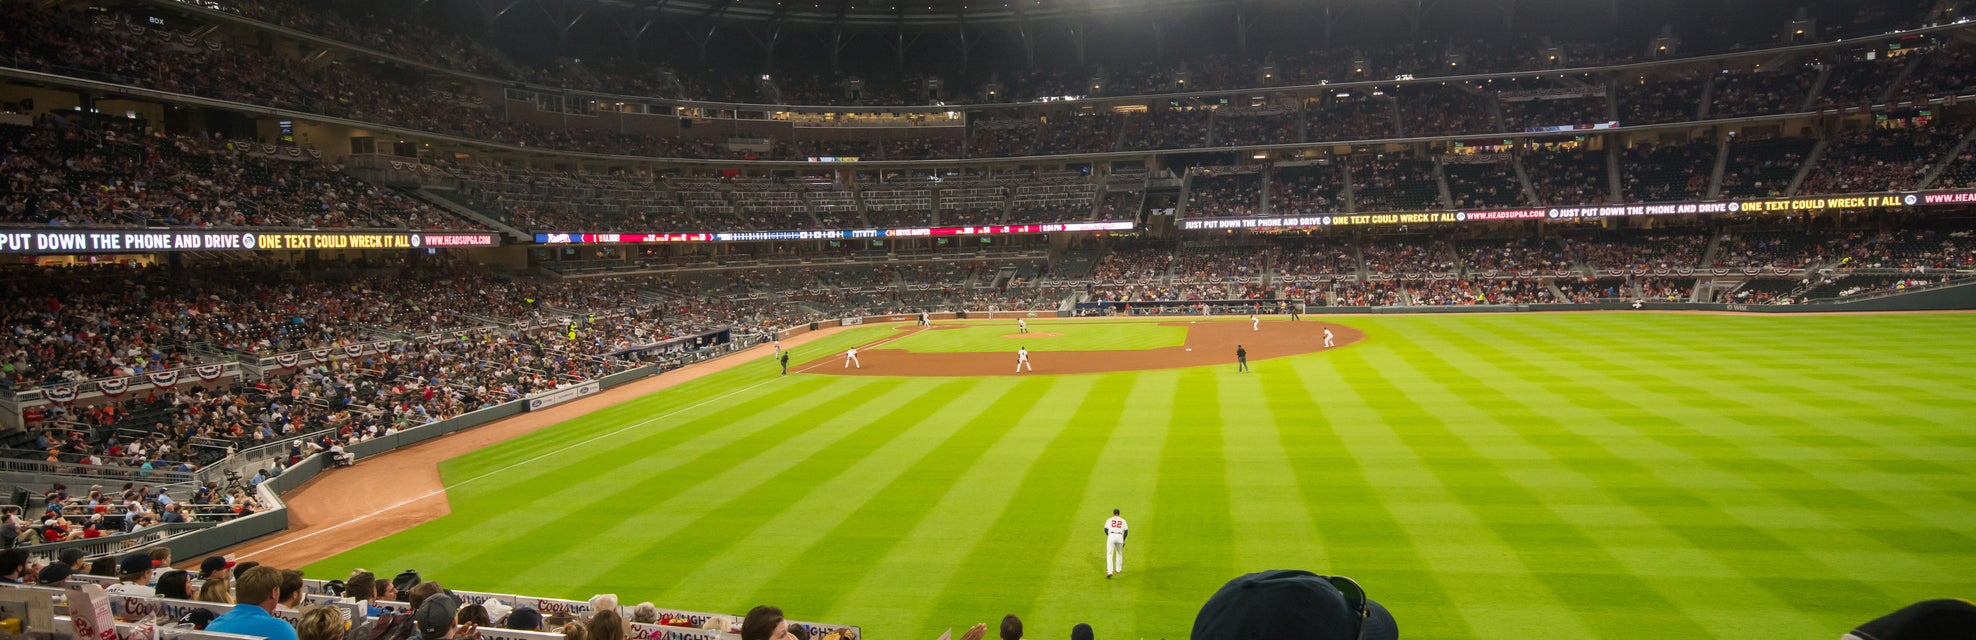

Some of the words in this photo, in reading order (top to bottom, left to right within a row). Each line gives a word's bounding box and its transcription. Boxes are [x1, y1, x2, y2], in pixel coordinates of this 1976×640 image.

[149, 16, 164, 25] BOX
[1741, 202, 1762, 211] ONE
[1765, 201, 1790, 210] TEXT
[1792, 200, 1825, 209] COULD
[1828, 198, 1865, 207] WRECK
[1868, 197, 1879, 206] IT
[1882, 196, 1901, 205] ALL
[1467, 210, 1545, 219] WWW.HEADSUPGA.COM
[1560, 209, 1579, 217] JUST
[1581, 208, 1598, 216] PUT
[1600, 207, 1625, 215] DOWN
[1627, 207, 1643, 215] THE
[1646, 205, 1675, 213] PHONE
[1678, 205, 1696, 213] AND
[1699, 204, 1726, 212] DRIVE
[1186, 221, 1202, 229] JUST
[1220, 220, 1240, 228] DOWN
[1258, 219, 1281, 227] PHONE
[1283, 218, 1298, 226] AND
[1300, 217, 1321, 225] DRIVE
[1333, 216, 1348, 225] ONE
[1350, 216, 1370, 224] TEXT
[1372, 215, 1398, 223] COULD
[1400, 214, 1429, 222] WRECK
[1431, 213, 1439, 221] IT
[1441, 213, 1456, 221] ALL
[37, 234, 86, 249] DOWN
[90, 234, 120, 249] THE
[125, 234, 171, 249] PHONE
[175, 234, 201, 248] AND
[205, 235, 240, 248] DRIVE
[258, 235, 282, 248] ONE
[284, 235, 312, 248] TEXT
[314, 235, 347, 248] COULD
[349, 235, 382, 248] WRECK
[384, 235, 393, 247] IT
[395, 235, 410, 247] ALL
[425, 235, 491, 245] WWW.HEADSUPGA.COM
[1111, 520, 1122, 528] 22
[537, 599, 569, 613] Coors
